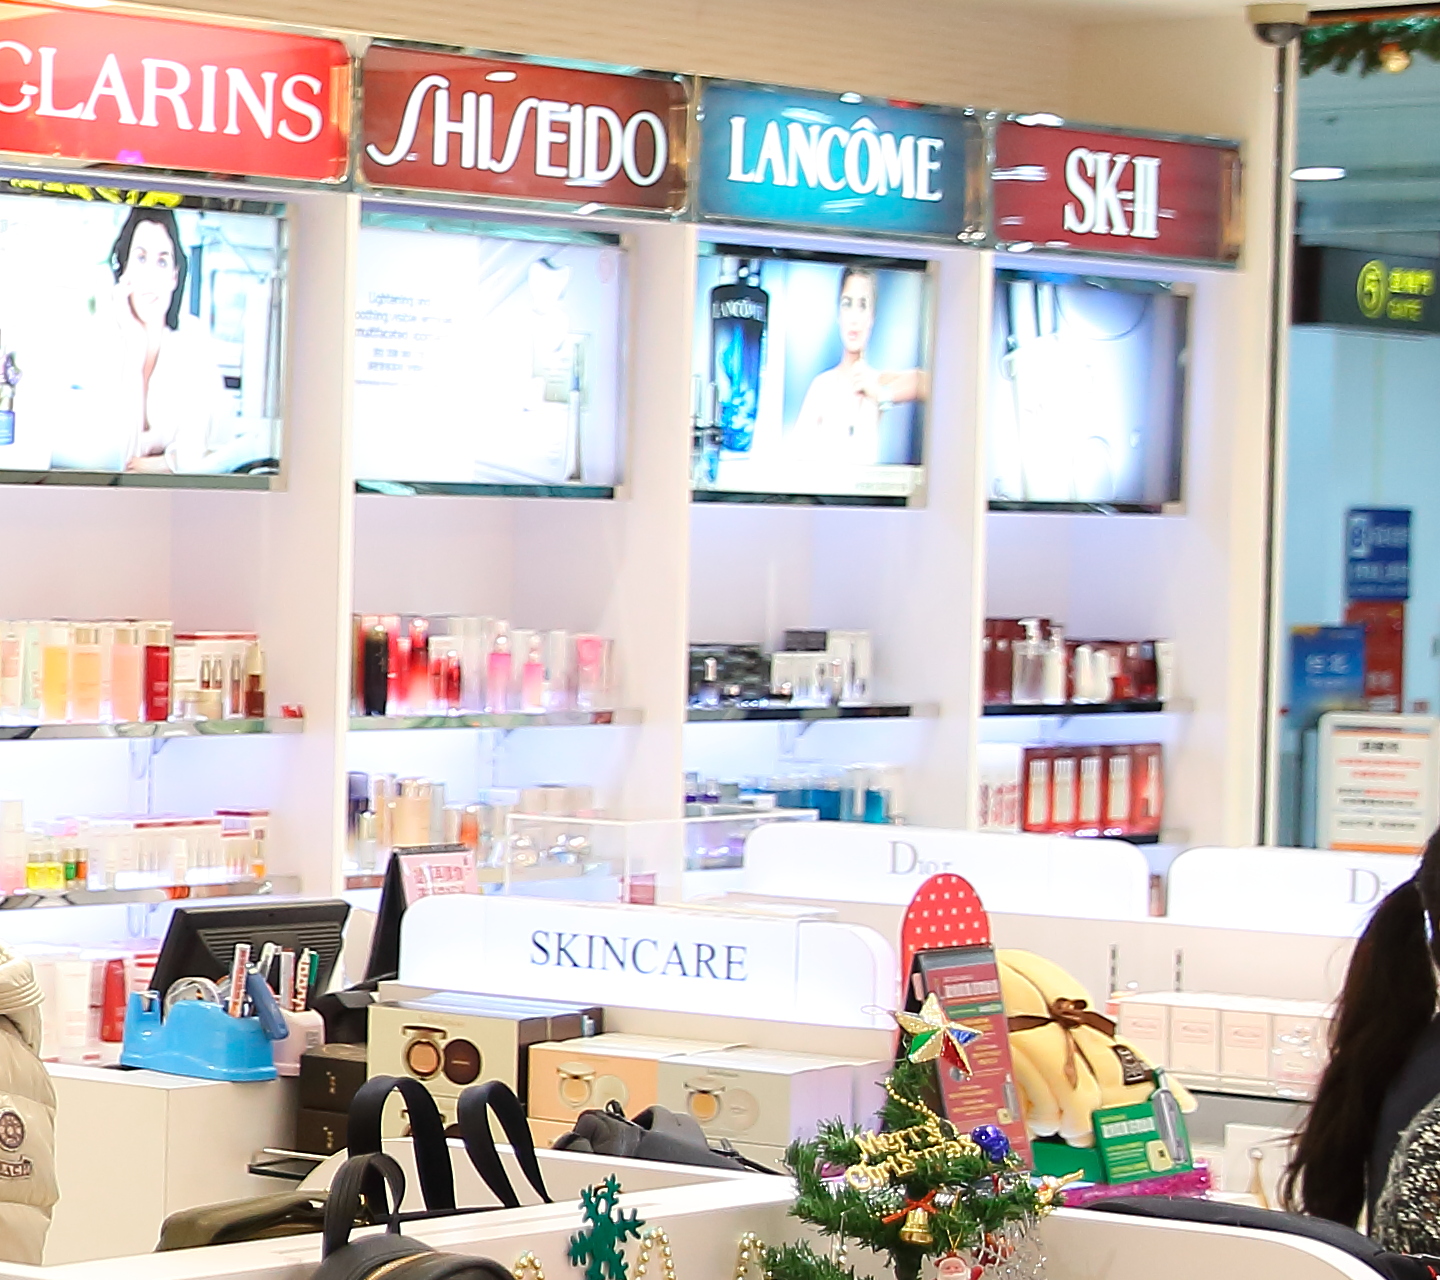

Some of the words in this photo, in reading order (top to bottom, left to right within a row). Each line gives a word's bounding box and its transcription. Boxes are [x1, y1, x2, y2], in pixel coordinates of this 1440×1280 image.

[365, 74, 669, 188] SHISEIDO
[726, 116, 944, 203] LANCÔME
[529, 928, 750, 983] SKINCARE
[854, 1119, 943, 1158] Merry
